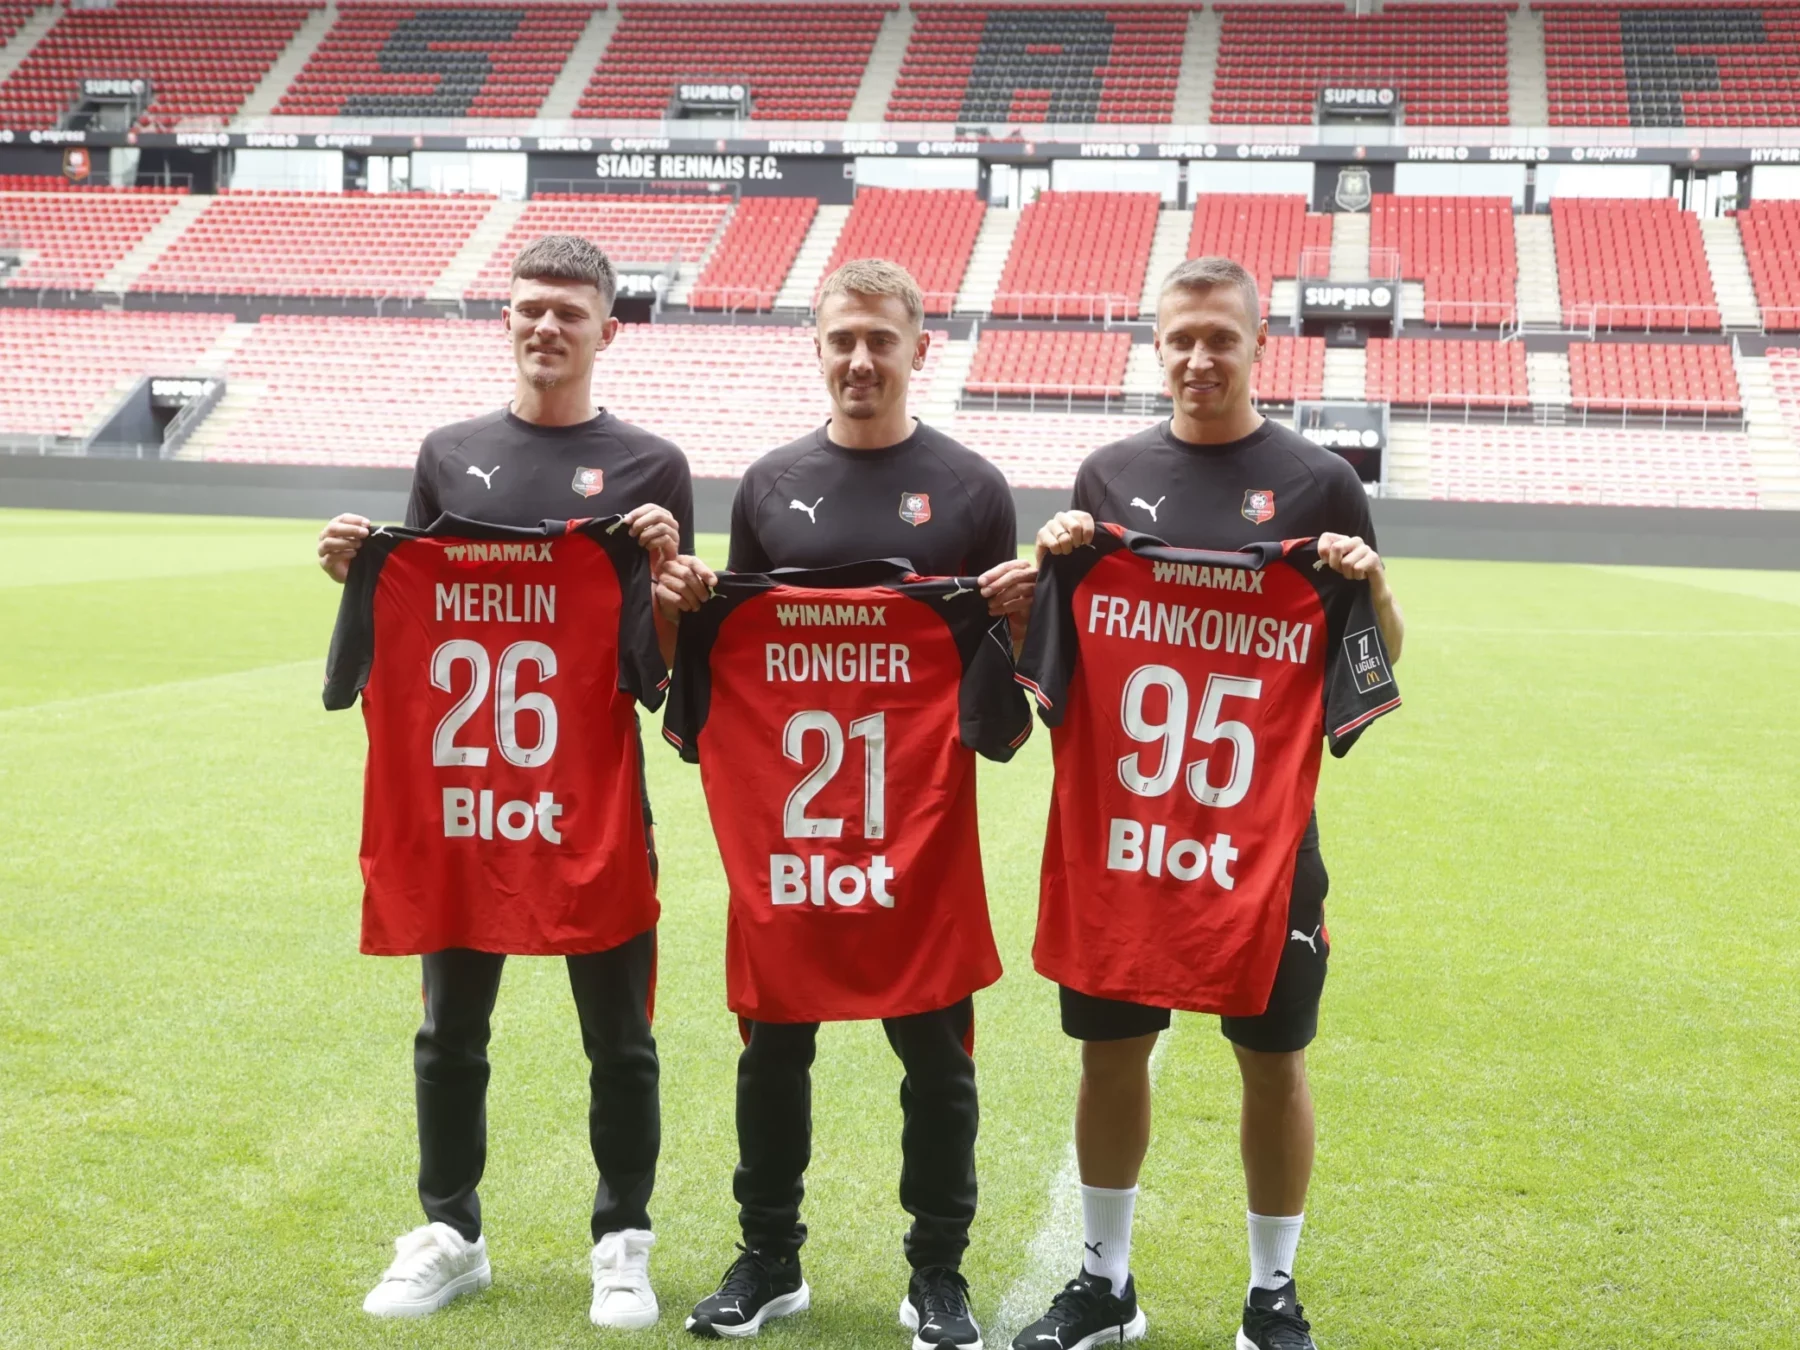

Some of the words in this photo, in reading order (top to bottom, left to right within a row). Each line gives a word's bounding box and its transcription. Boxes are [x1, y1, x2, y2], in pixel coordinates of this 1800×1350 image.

[84, 79, 131, 95] SUPER
[680, 85, 729, 100] SUPER
[1324, 88, 1377, 104] SUPER
[176, 133, 218, 146] HYPER
[246, 133, 287, 147] SUPER
[466, 137, 508, 150] HYPER
[538, 137, 580, 151] SUPER
[769, 139, 813, 153] HYPER
[843, 140, 886, 154] SUPER
[931, 141, 979, 156] express
[1080, 143, 1127, 157] HYPER
[1159, 144, 1204, 158] SUPER
[1251, 144, 1301, 159] express
[1408, 146, 1456, 160] HYPER
[1490, 147, 1536, 161] SUPER
[1586, 147, 1638, 162] express
[1750, 148, 1800, 162] HYPER
[596, 154, 655, 178] STADE
[660, 155, 745, 179] RENNAIS
[749, 156, 783, 180] F.C.
[1305, 287, 1371, 306] SUPER
[444, 542, 553, 562] WINAMAX
[1153, 560, 1266, 595] WINAMAX
[435, 583, 556, 623] MERLIN
[776, 604, 888, 626] WINAMAX
[1088, 594, 1313, 664] FRANKOWSKI
[765, 643, 911, 683] RONGIER
[430, 639, 559, 768] 26
[1117, 664, 1263, 808] 95
[782, 710, 885, 840] 21
[442, 787, 563, 845] Blot
[1106, 817, 1239, 891] Blot
[769, 854, 895, 908] Blot
